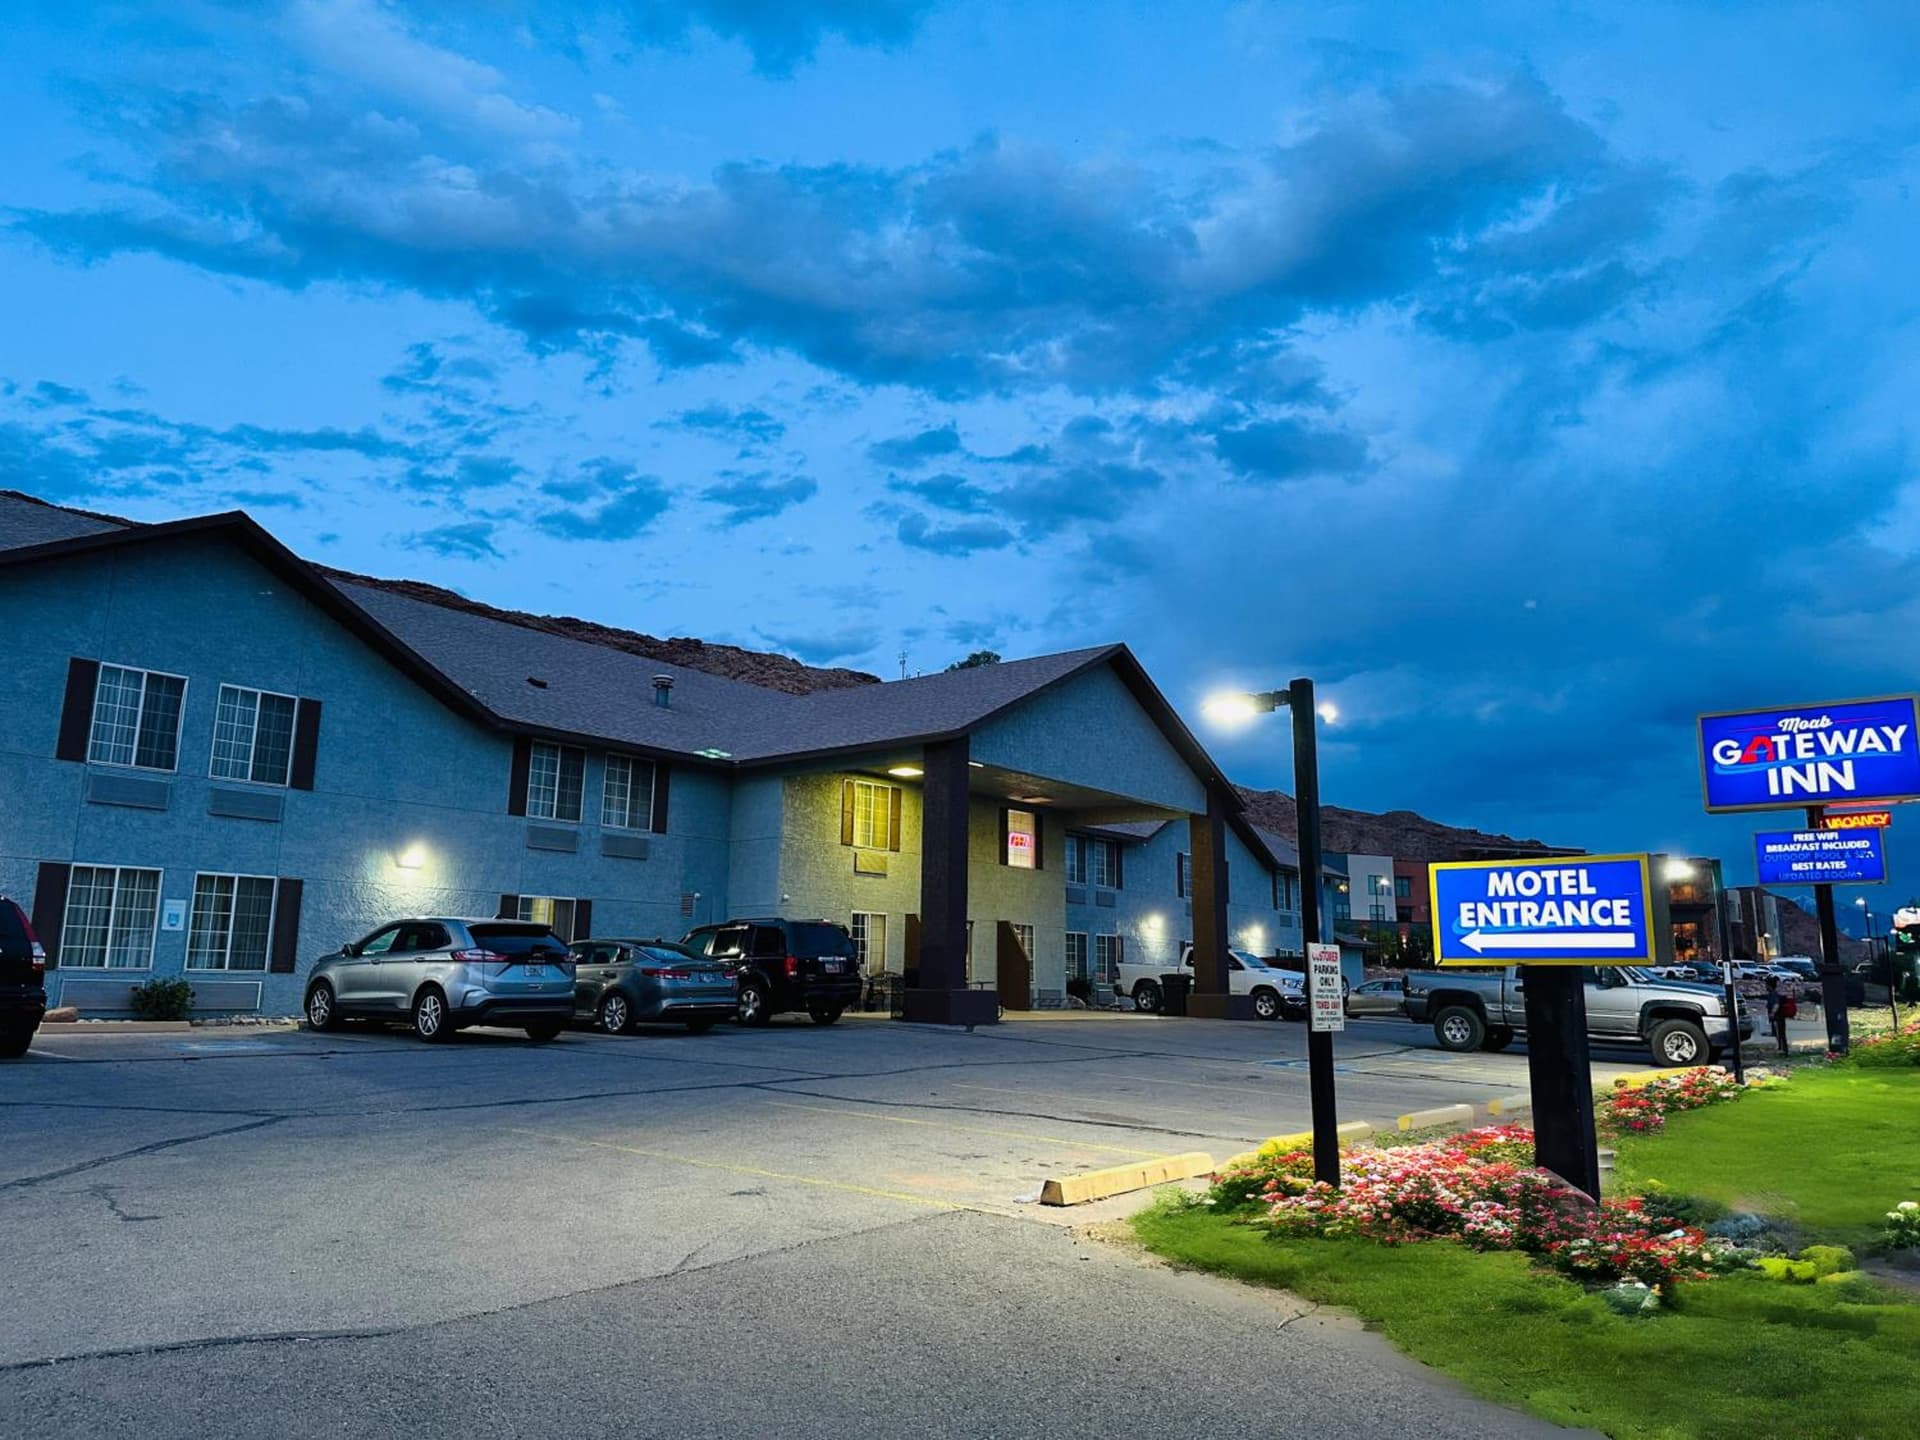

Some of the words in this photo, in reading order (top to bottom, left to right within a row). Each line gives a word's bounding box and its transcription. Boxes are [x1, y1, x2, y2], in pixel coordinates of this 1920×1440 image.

[1778, 715, 1833, 733] Moab
[1712, 724, 1908, 766] GATEWAY
[1767, 760, 1856, 796] INN
[1826, 813, 1889, 829] VACANCY
[1793, 833, 1815, 842] FREE
[1766, 843, 1820, 853] BREAKFAST
[1822, 840, 1870, 850] INCLUDED
[1792, 862, 1814, 871] BEST
[1816, 861, 1847, 870] RATES
[1487, 869, 1597, 897] MOTEL
[1460, 900, 1632, 928] ENTRANCE
[1314, 964, 1338, 975] PARKING
[1320, 977, 1335, 987] ONLY
